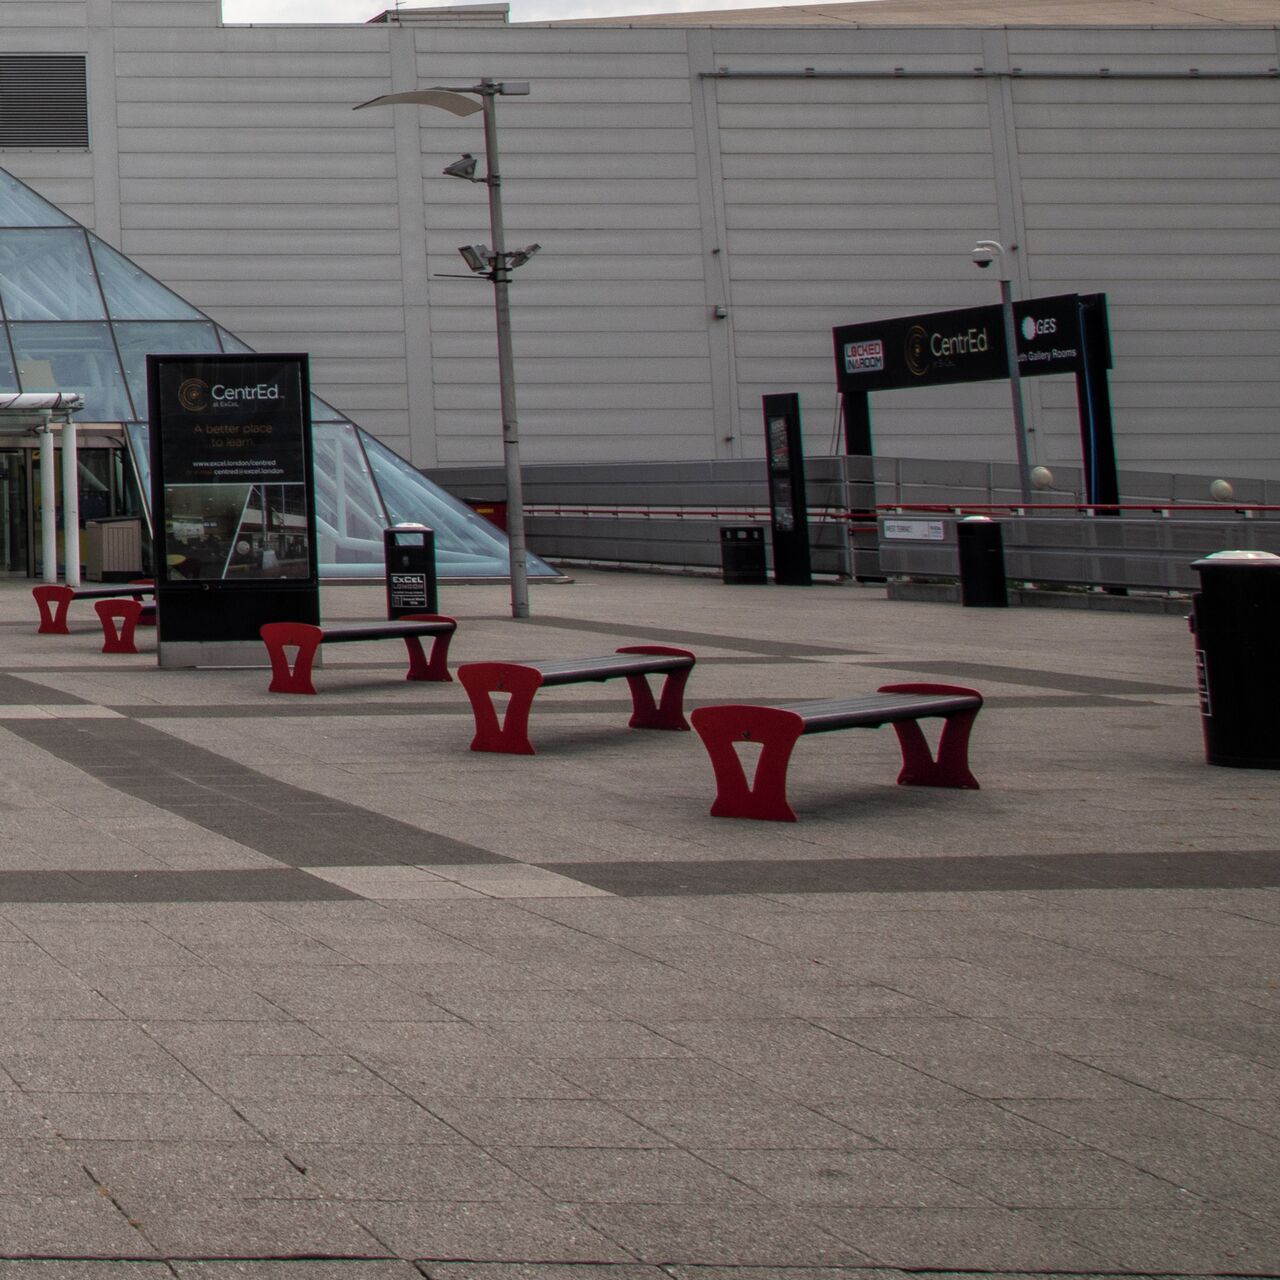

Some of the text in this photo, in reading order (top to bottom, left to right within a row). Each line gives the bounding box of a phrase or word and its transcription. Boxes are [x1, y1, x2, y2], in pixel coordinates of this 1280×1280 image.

[1036, 318, 1057, 335] GES
[930, 328, 989, 357] CentrEd
[846, 343, 881, 358] LOCKED
[1028, 350, 1051, 362] Gallery
[1052, 348, 1077, 359] Rooms
[211, 384, 279, 400] CentrEd
[206, 424, 241, 434] better
[242, 424, 272, 435] place
